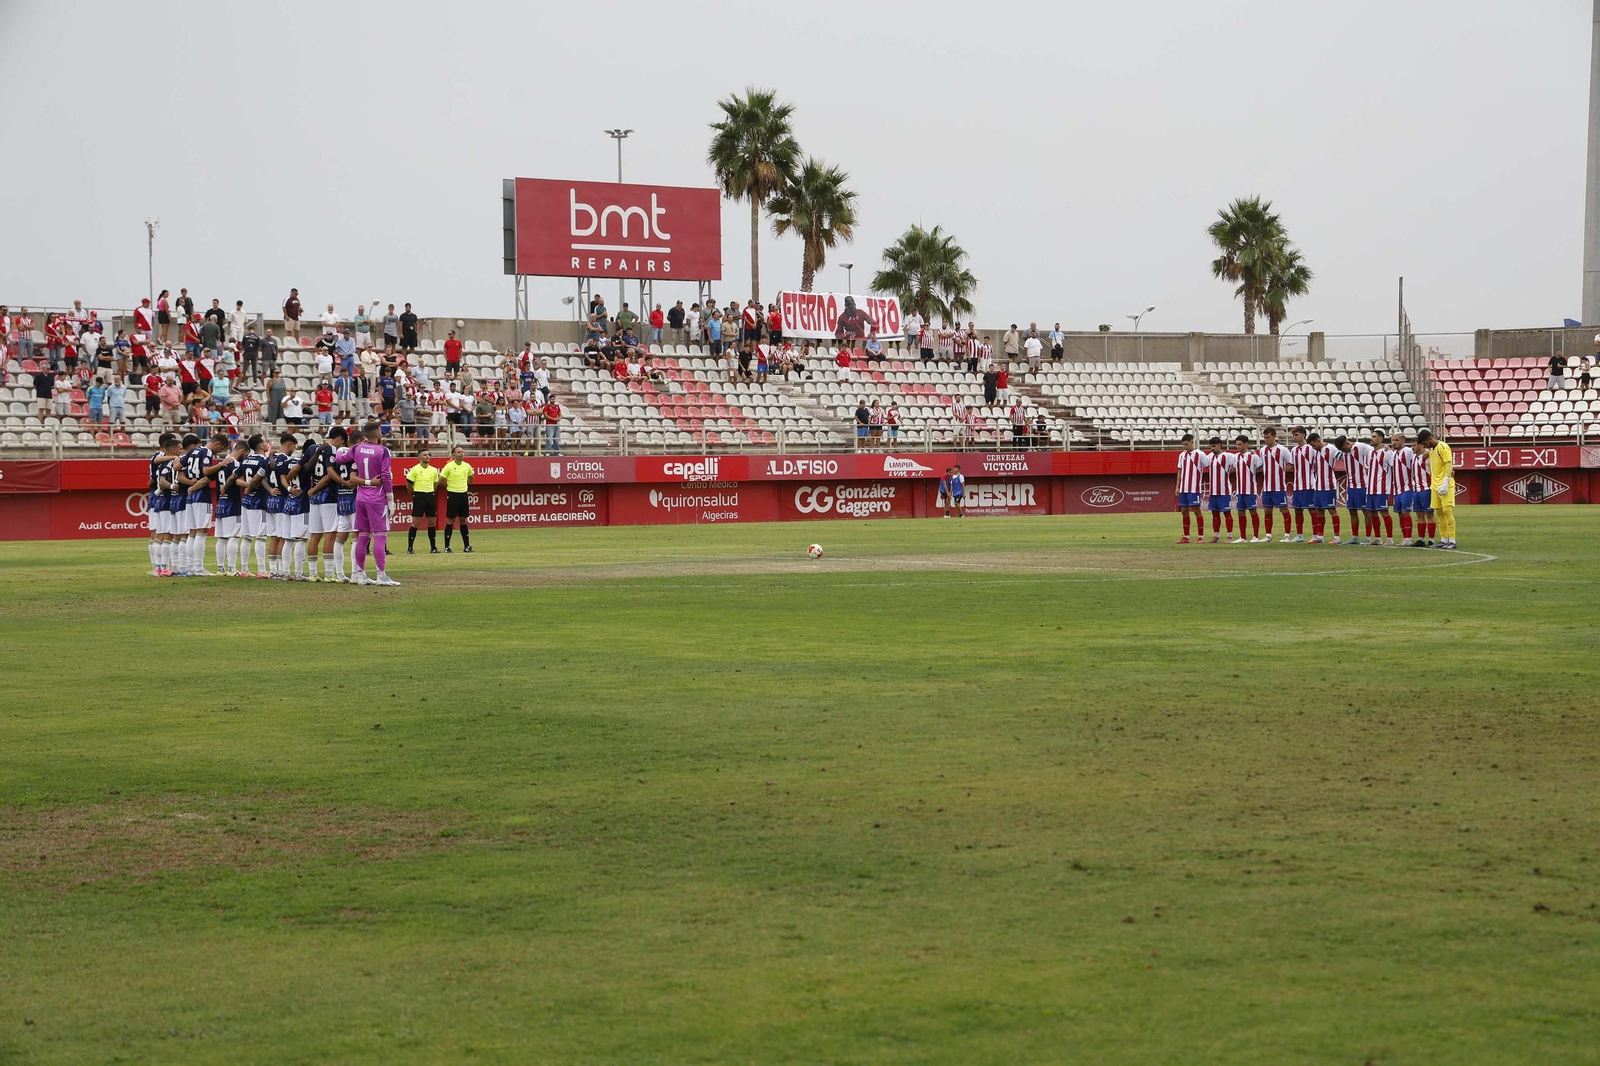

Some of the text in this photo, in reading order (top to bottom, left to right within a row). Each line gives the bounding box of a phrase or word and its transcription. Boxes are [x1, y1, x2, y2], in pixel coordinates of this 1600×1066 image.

[570, 188, 671, 240] bmt
[571, 257, 670, 272] REPAIRS
[782, 293, 837, 332] ETERNO
[187, 457, 201, 479] 24
[363, 457, 370, 480] 1
[477, 466, 505, 475] LUMAR
[566, 461, 605, 471] FÚTBOL
[663, 457, 719, 480] capelli
[983, 462, 1029, 471] VICTORIA
[566, 472, 605, 480] COALITION
[689, 474, 719, 482] SPORT
[836, 483, 895, 499] González
[1089, 488, 1115, 503] Ford
[492, 490, 567, 511] populares
[702, 511, 738, 521] Algeciras
[836, 500, 891, 517] Gaggero
[483, 514, 494, 523] EL
[496, 513, 537, 523] DEPORTE
[539, 510, 596, 522] ALGECIREÑO
[79, 522, 101, 530] Audi
[104, 522, 138, 530] Center
